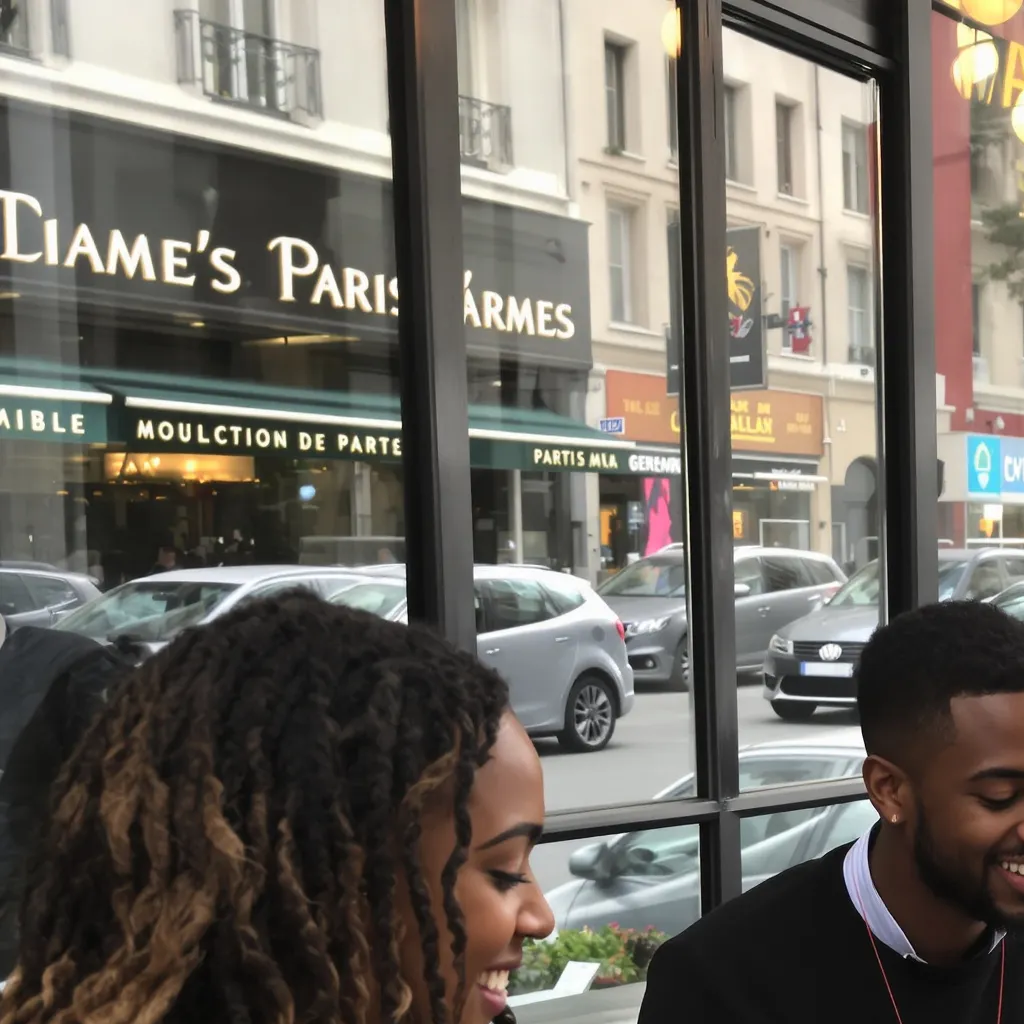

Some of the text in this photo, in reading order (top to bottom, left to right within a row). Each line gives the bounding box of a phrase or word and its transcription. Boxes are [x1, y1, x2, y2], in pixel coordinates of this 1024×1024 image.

[137, 419, 288, 450] MOULCTION
[299, 431, 326, 452] DE
[533, 448, 586, 467] PARTIS
